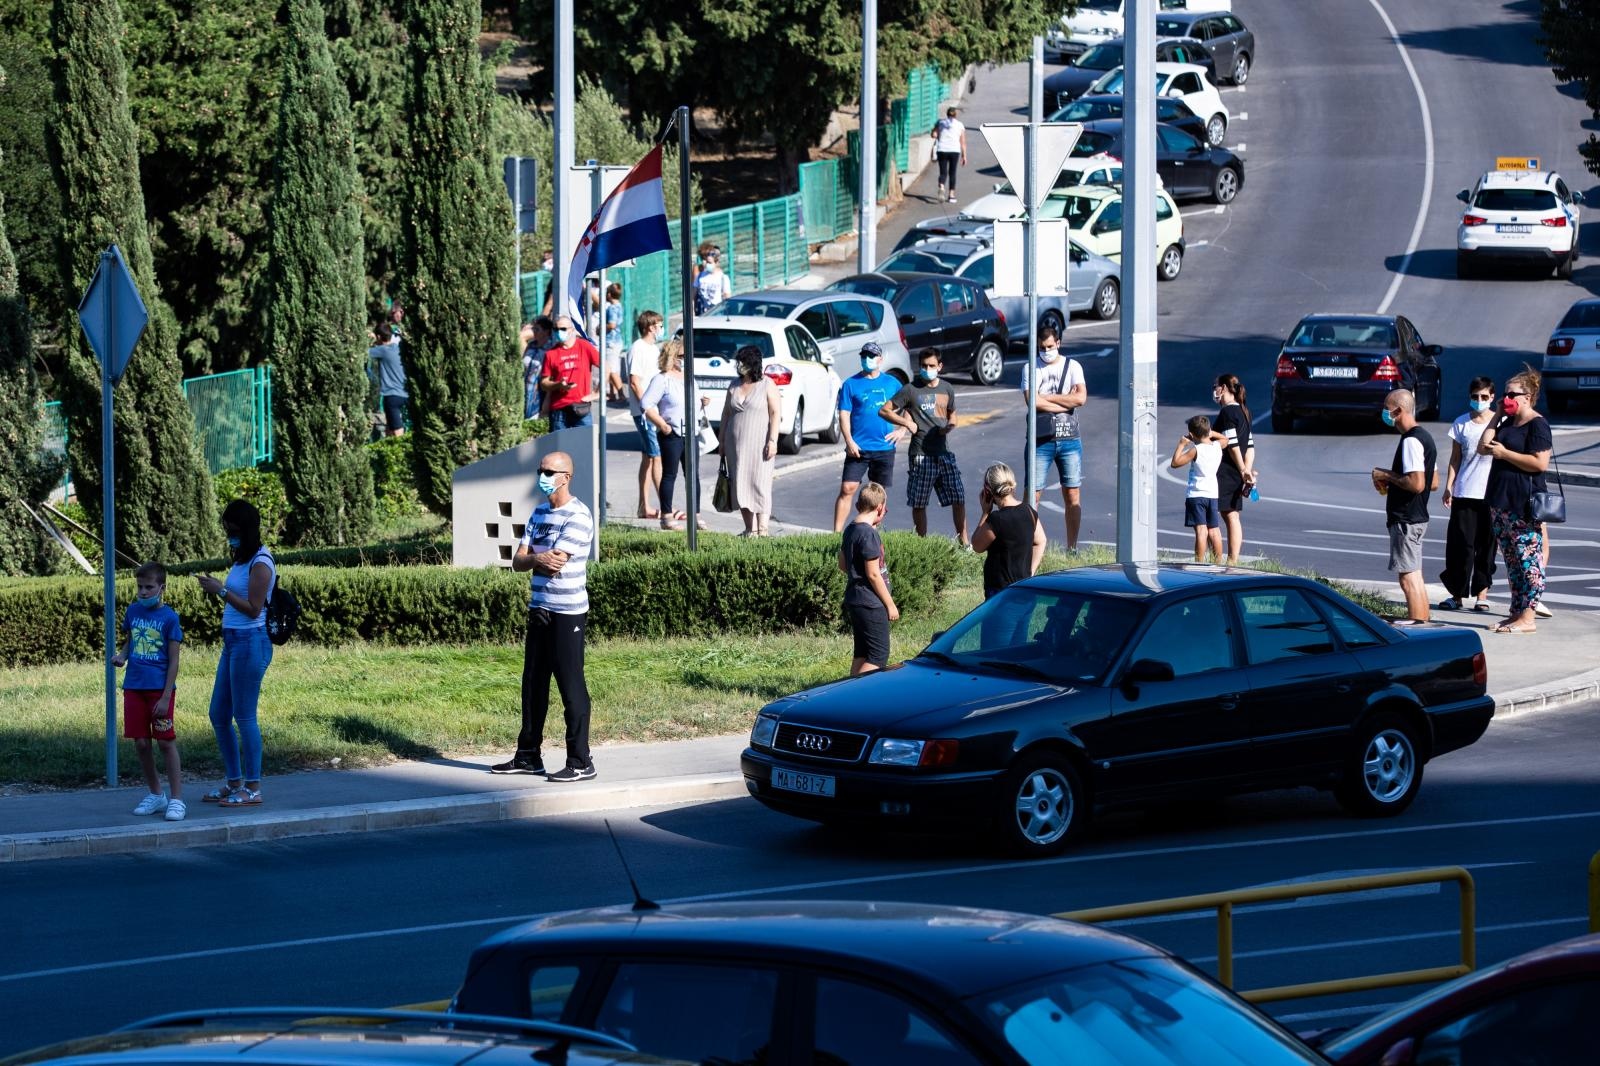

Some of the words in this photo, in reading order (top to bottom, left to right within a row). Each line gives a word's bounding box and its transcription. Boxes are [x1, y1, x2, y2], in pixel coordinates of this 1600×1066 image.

[131, 618, 164, 631] HAWAII
[777, 771, 788, 788] MA
[796, 774, 826, 793] 681-Z
